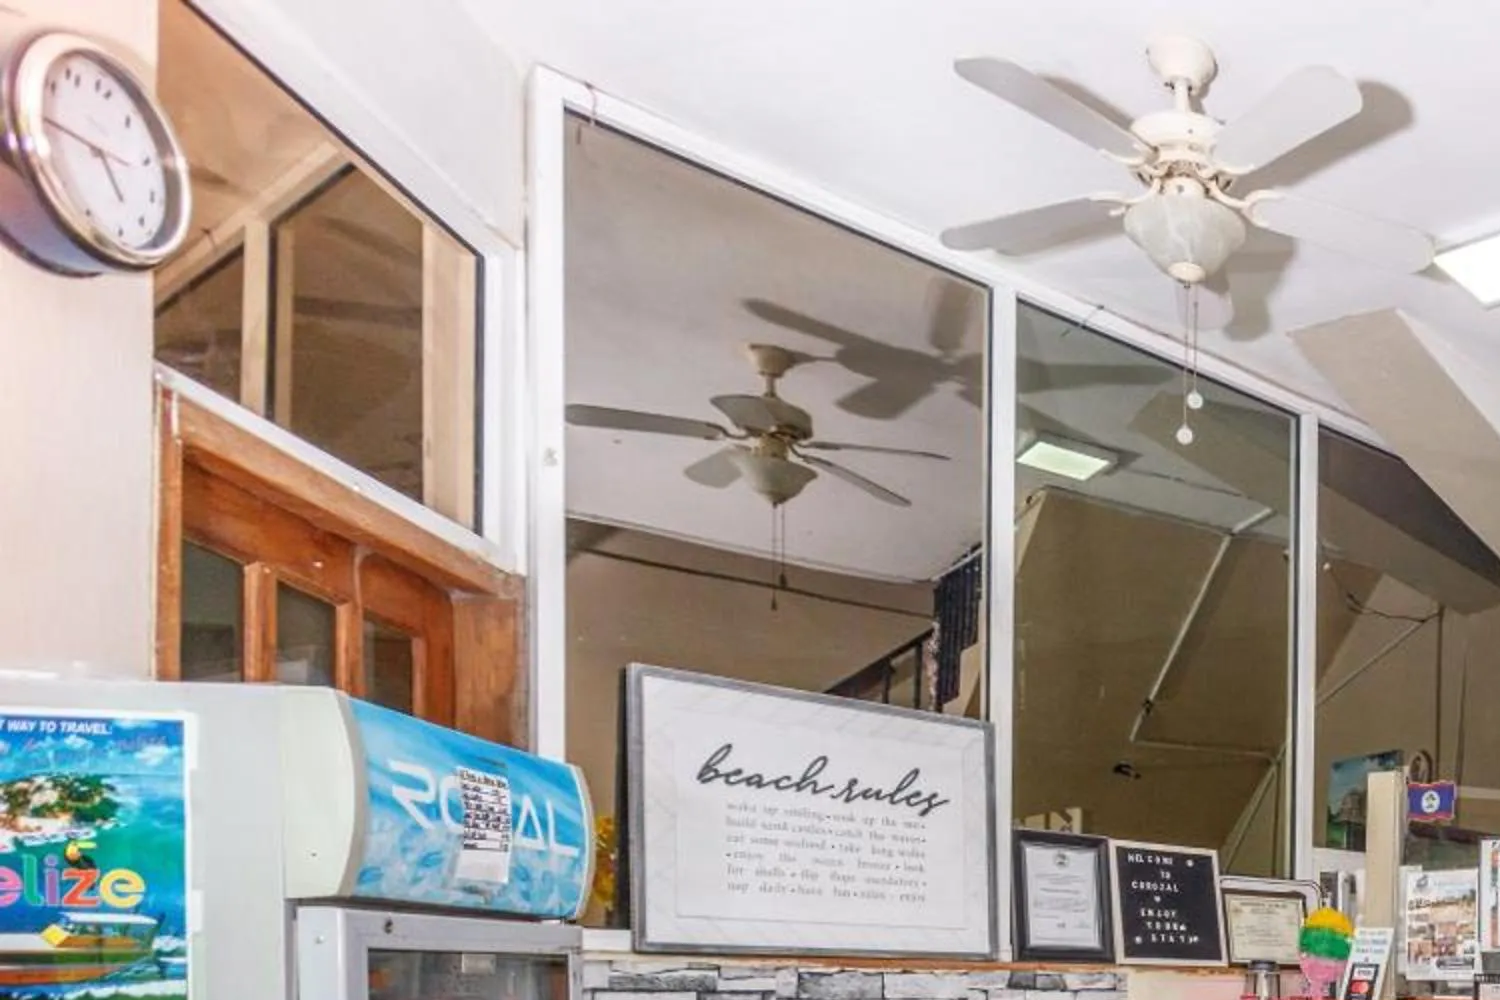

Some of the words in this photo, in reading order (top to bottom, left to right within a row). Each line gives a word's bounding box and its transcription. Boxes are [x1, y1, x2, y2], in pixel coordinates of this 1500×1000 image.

[7, 719, 36, 733] WAY
[39, 720, 57, 733] TO
[696, 743, 834, 796] beach
[831, 768, 950, 817] rules
[1127, 853, 1174, 866] WELCOME
